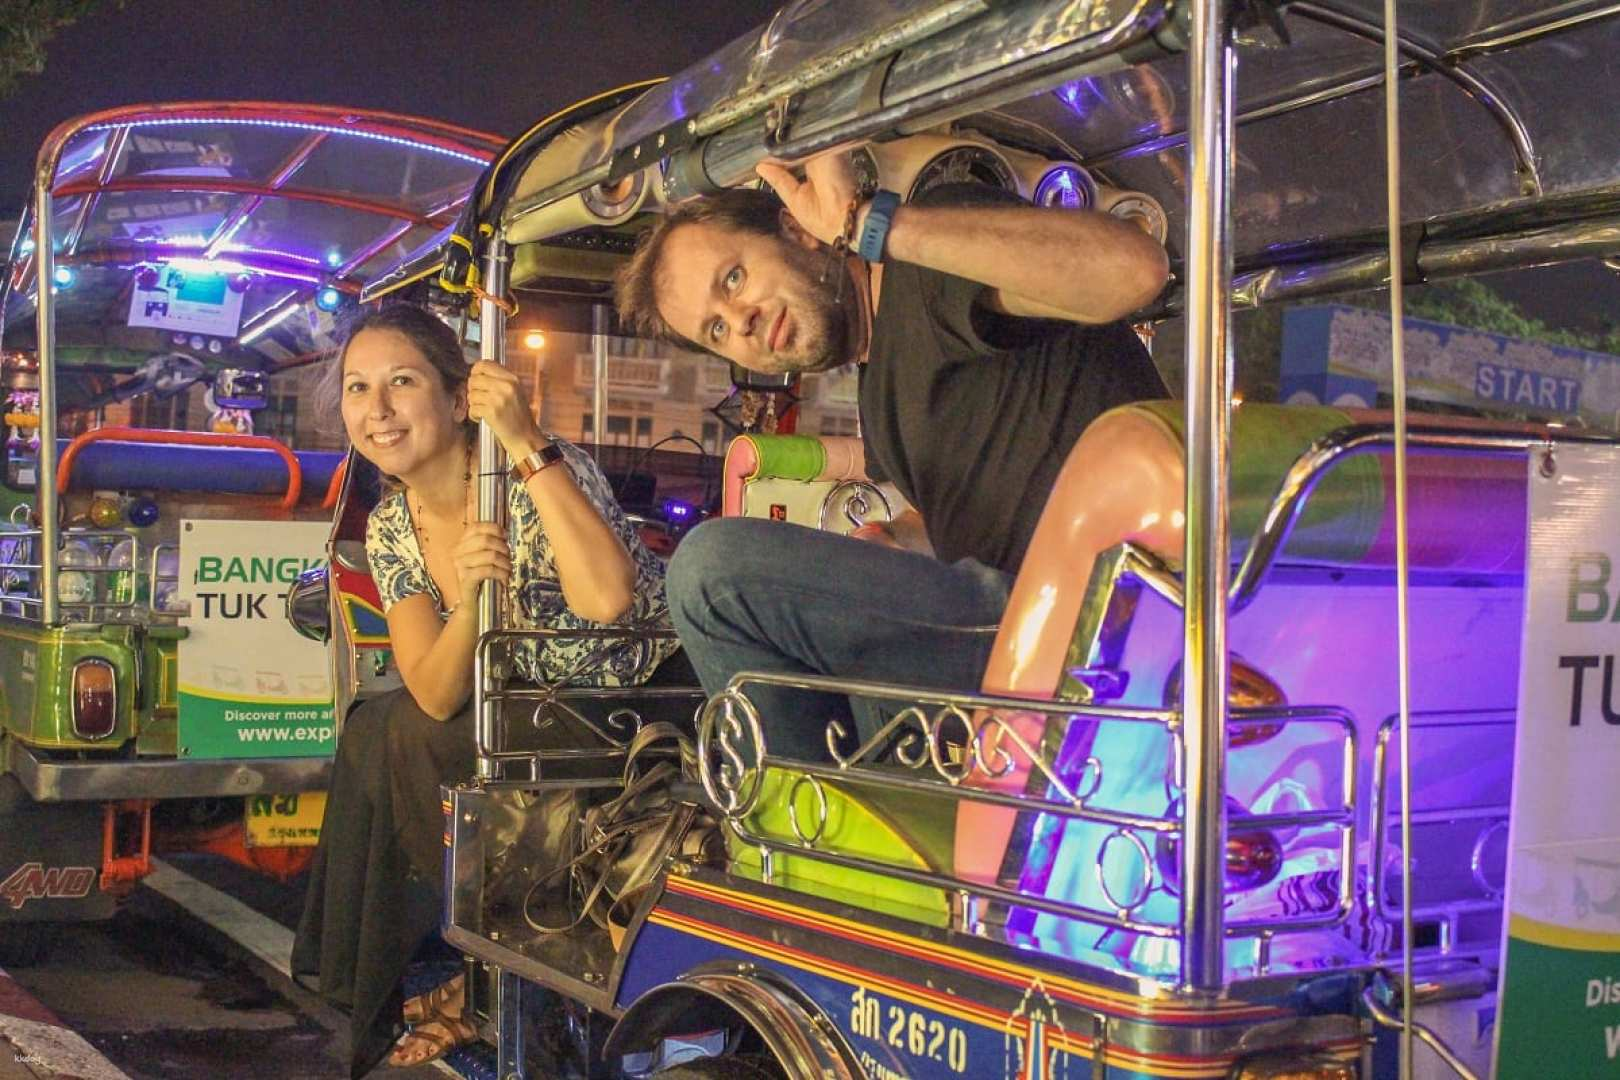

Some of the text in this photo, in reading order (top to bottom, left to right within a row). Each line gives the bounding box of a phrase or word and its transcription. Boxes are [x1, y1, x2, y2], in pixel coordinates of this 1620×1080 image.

[1476, 365, 1577, 412] START
[196, 593, 267, 619] TUK
[224, 709, 280, 721] Discover
[285, 710, 317, 720] more
[0, 862, 96, 909] 4WD
[887, 1006, 967, 1073] 2620
